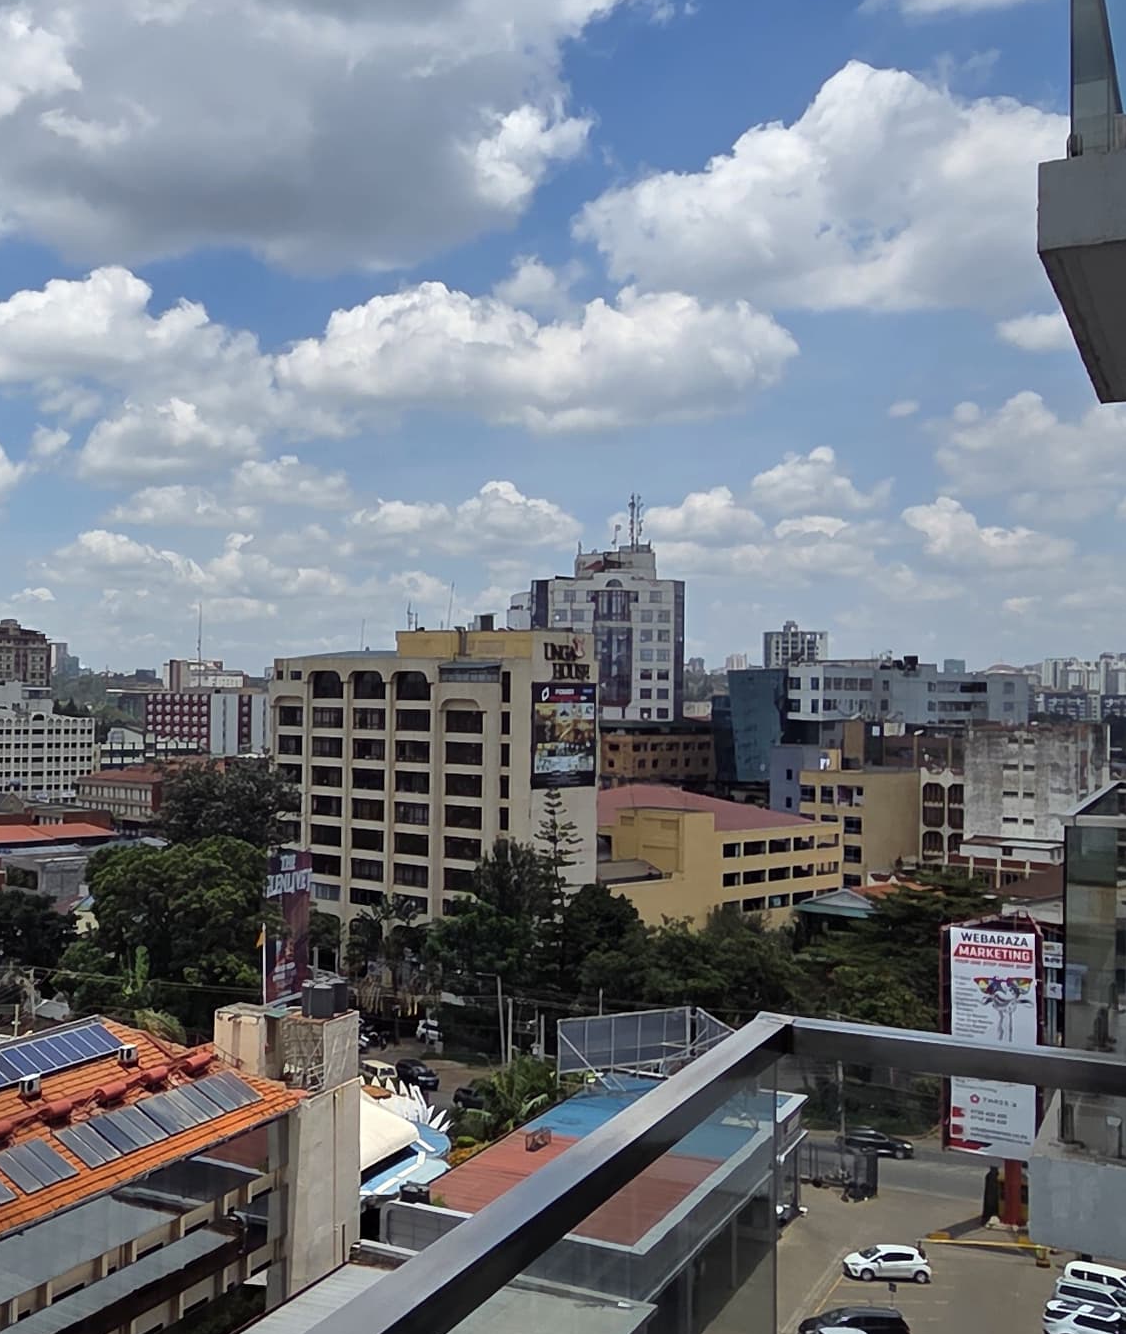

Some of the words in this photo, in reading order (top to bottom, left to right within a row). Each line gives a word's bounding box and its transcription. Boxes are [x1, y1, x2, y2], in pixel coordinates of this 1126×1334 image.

[544, 643, 577, 661] UNGA
[961, 932, 1028, 947] WEBARAZA
[959, 946, 1030, 961] MARKETING
